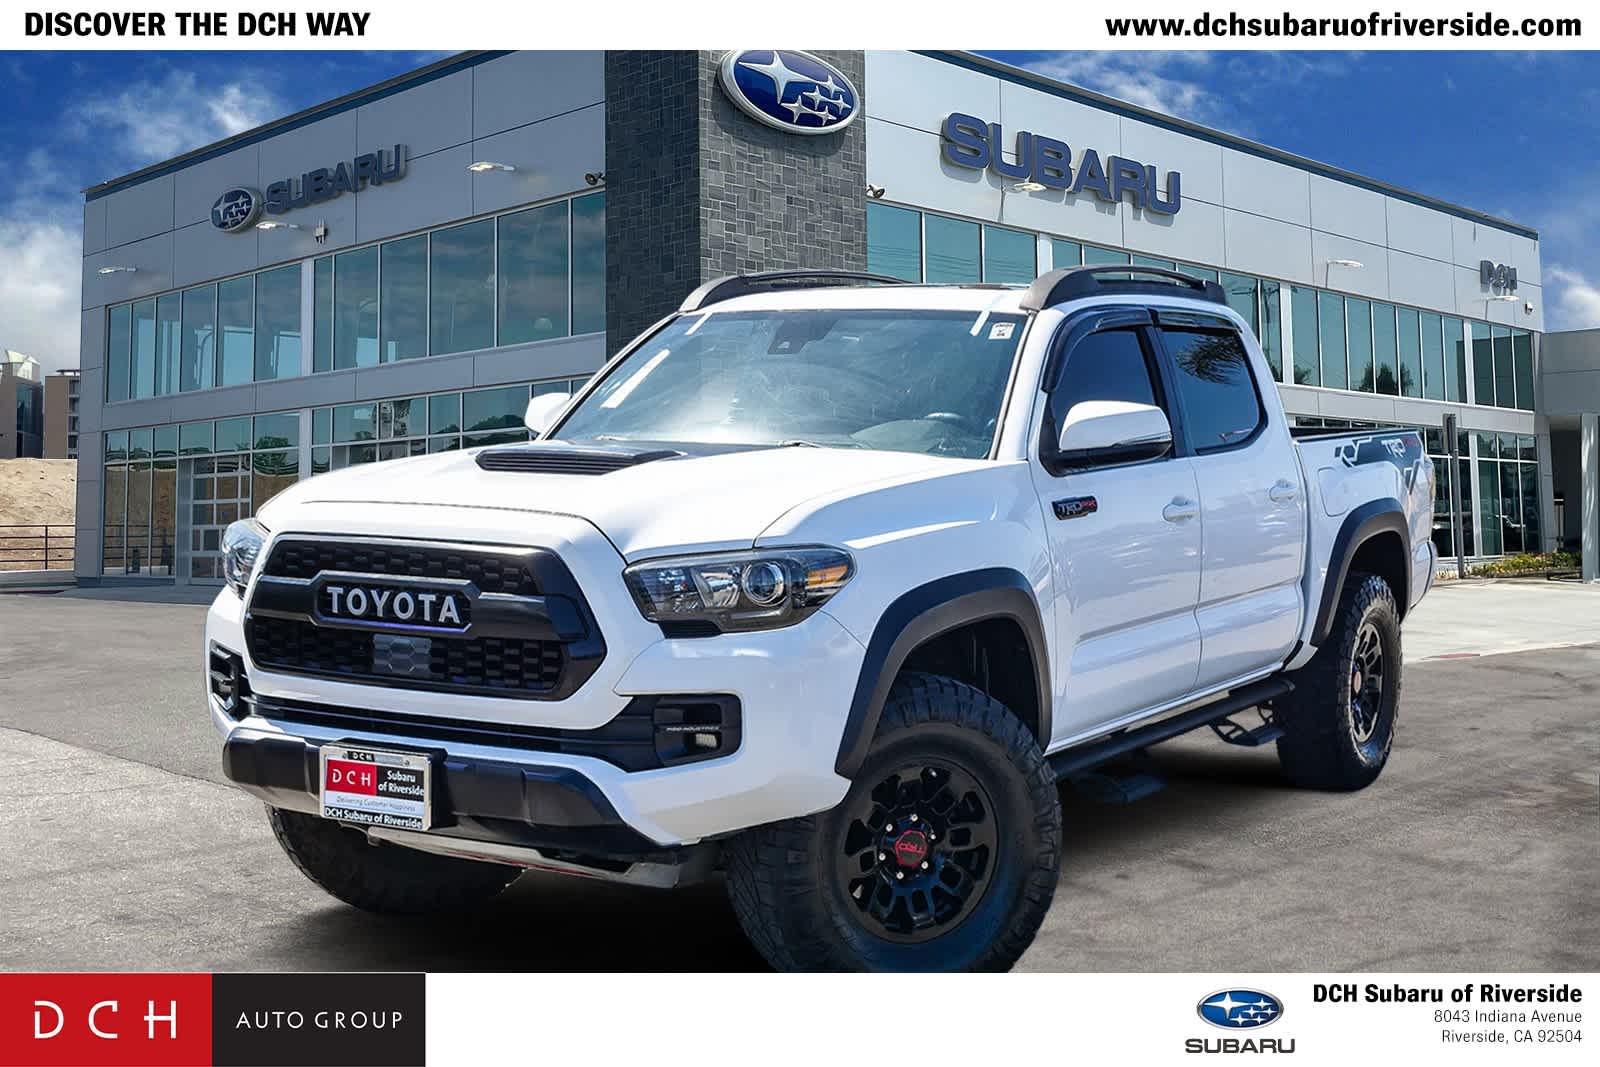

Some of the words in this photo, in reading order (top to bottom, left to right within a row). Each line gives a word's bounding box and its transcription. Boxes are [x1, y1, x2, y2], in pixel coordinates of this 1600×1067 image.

[941, 112, 1181, 216] SUBARU
[265, 144, 407, 215] SUBARU
[1057, 501, 1082, 515] TRD
[326, 586, 461, 624] TOYOTA
[332, 769, 371, 787] DCH
[387, 770, 416, 783] Subaru
[378, 781, 388, 792] of
[389, 783, 425, 797] Riverside
[325, 807, 343, 817] DCH
[343, 809, 373, 822] Subaru
[374, 814, 383, 824] of
[384, 815, 423, 830] Riverside
